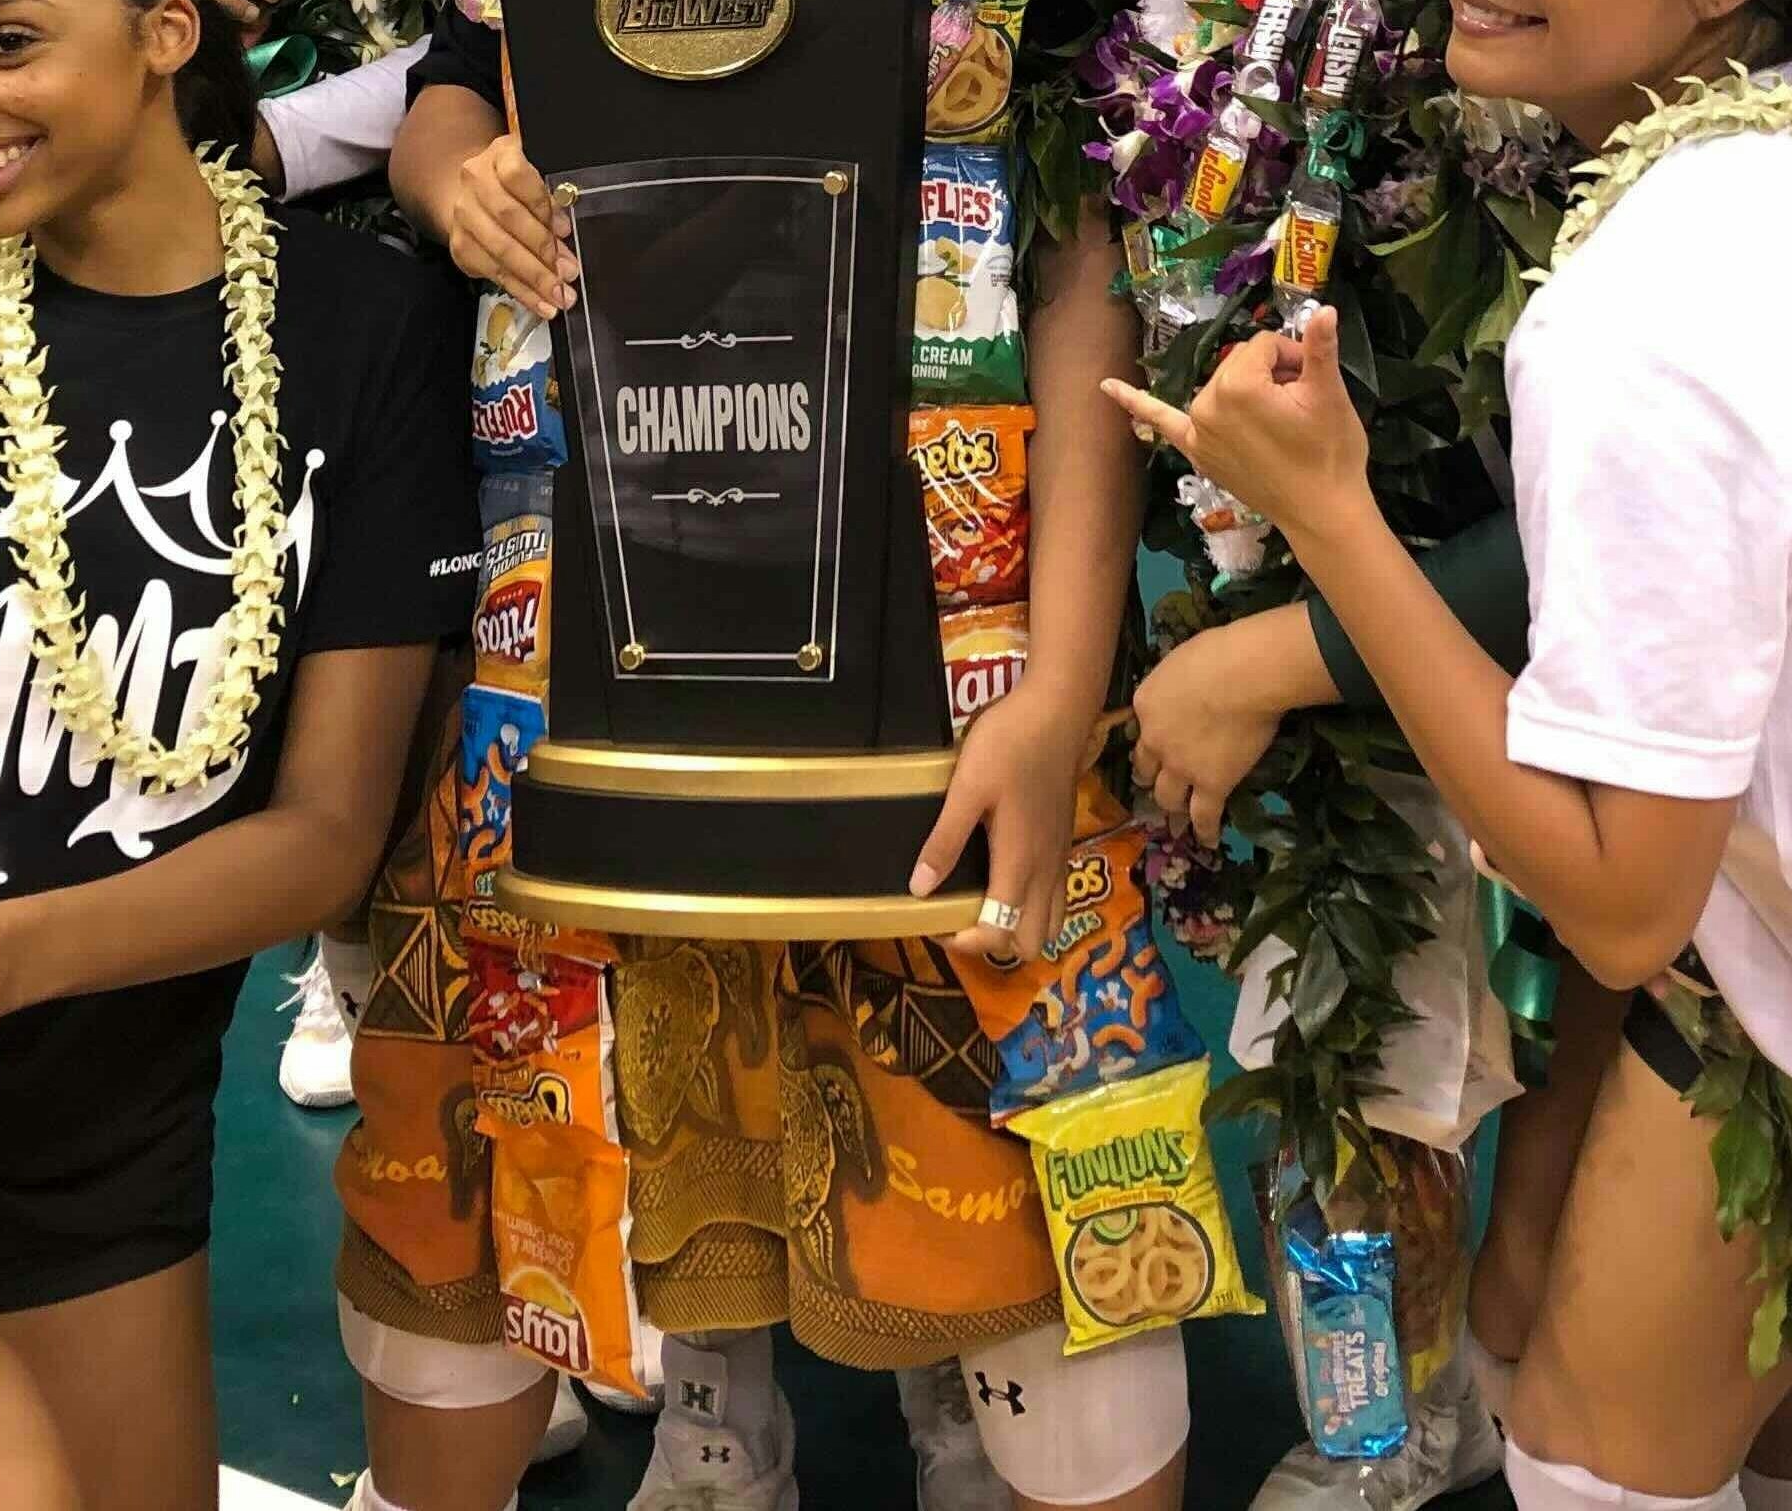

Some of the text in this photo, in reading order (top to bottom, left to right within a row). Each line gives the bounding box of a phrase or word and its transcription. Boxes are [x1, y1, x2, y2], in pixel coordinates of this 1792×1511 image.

[912, 364, 948, 380] ONION
[919, 346, 974, 366] CREAM
[615, 382, 812, 454] CHAMPIONS
[1047, 1125, 1192, 1211] FUNYUNS
[1343, 1330, 1371, 1408] TREATS
